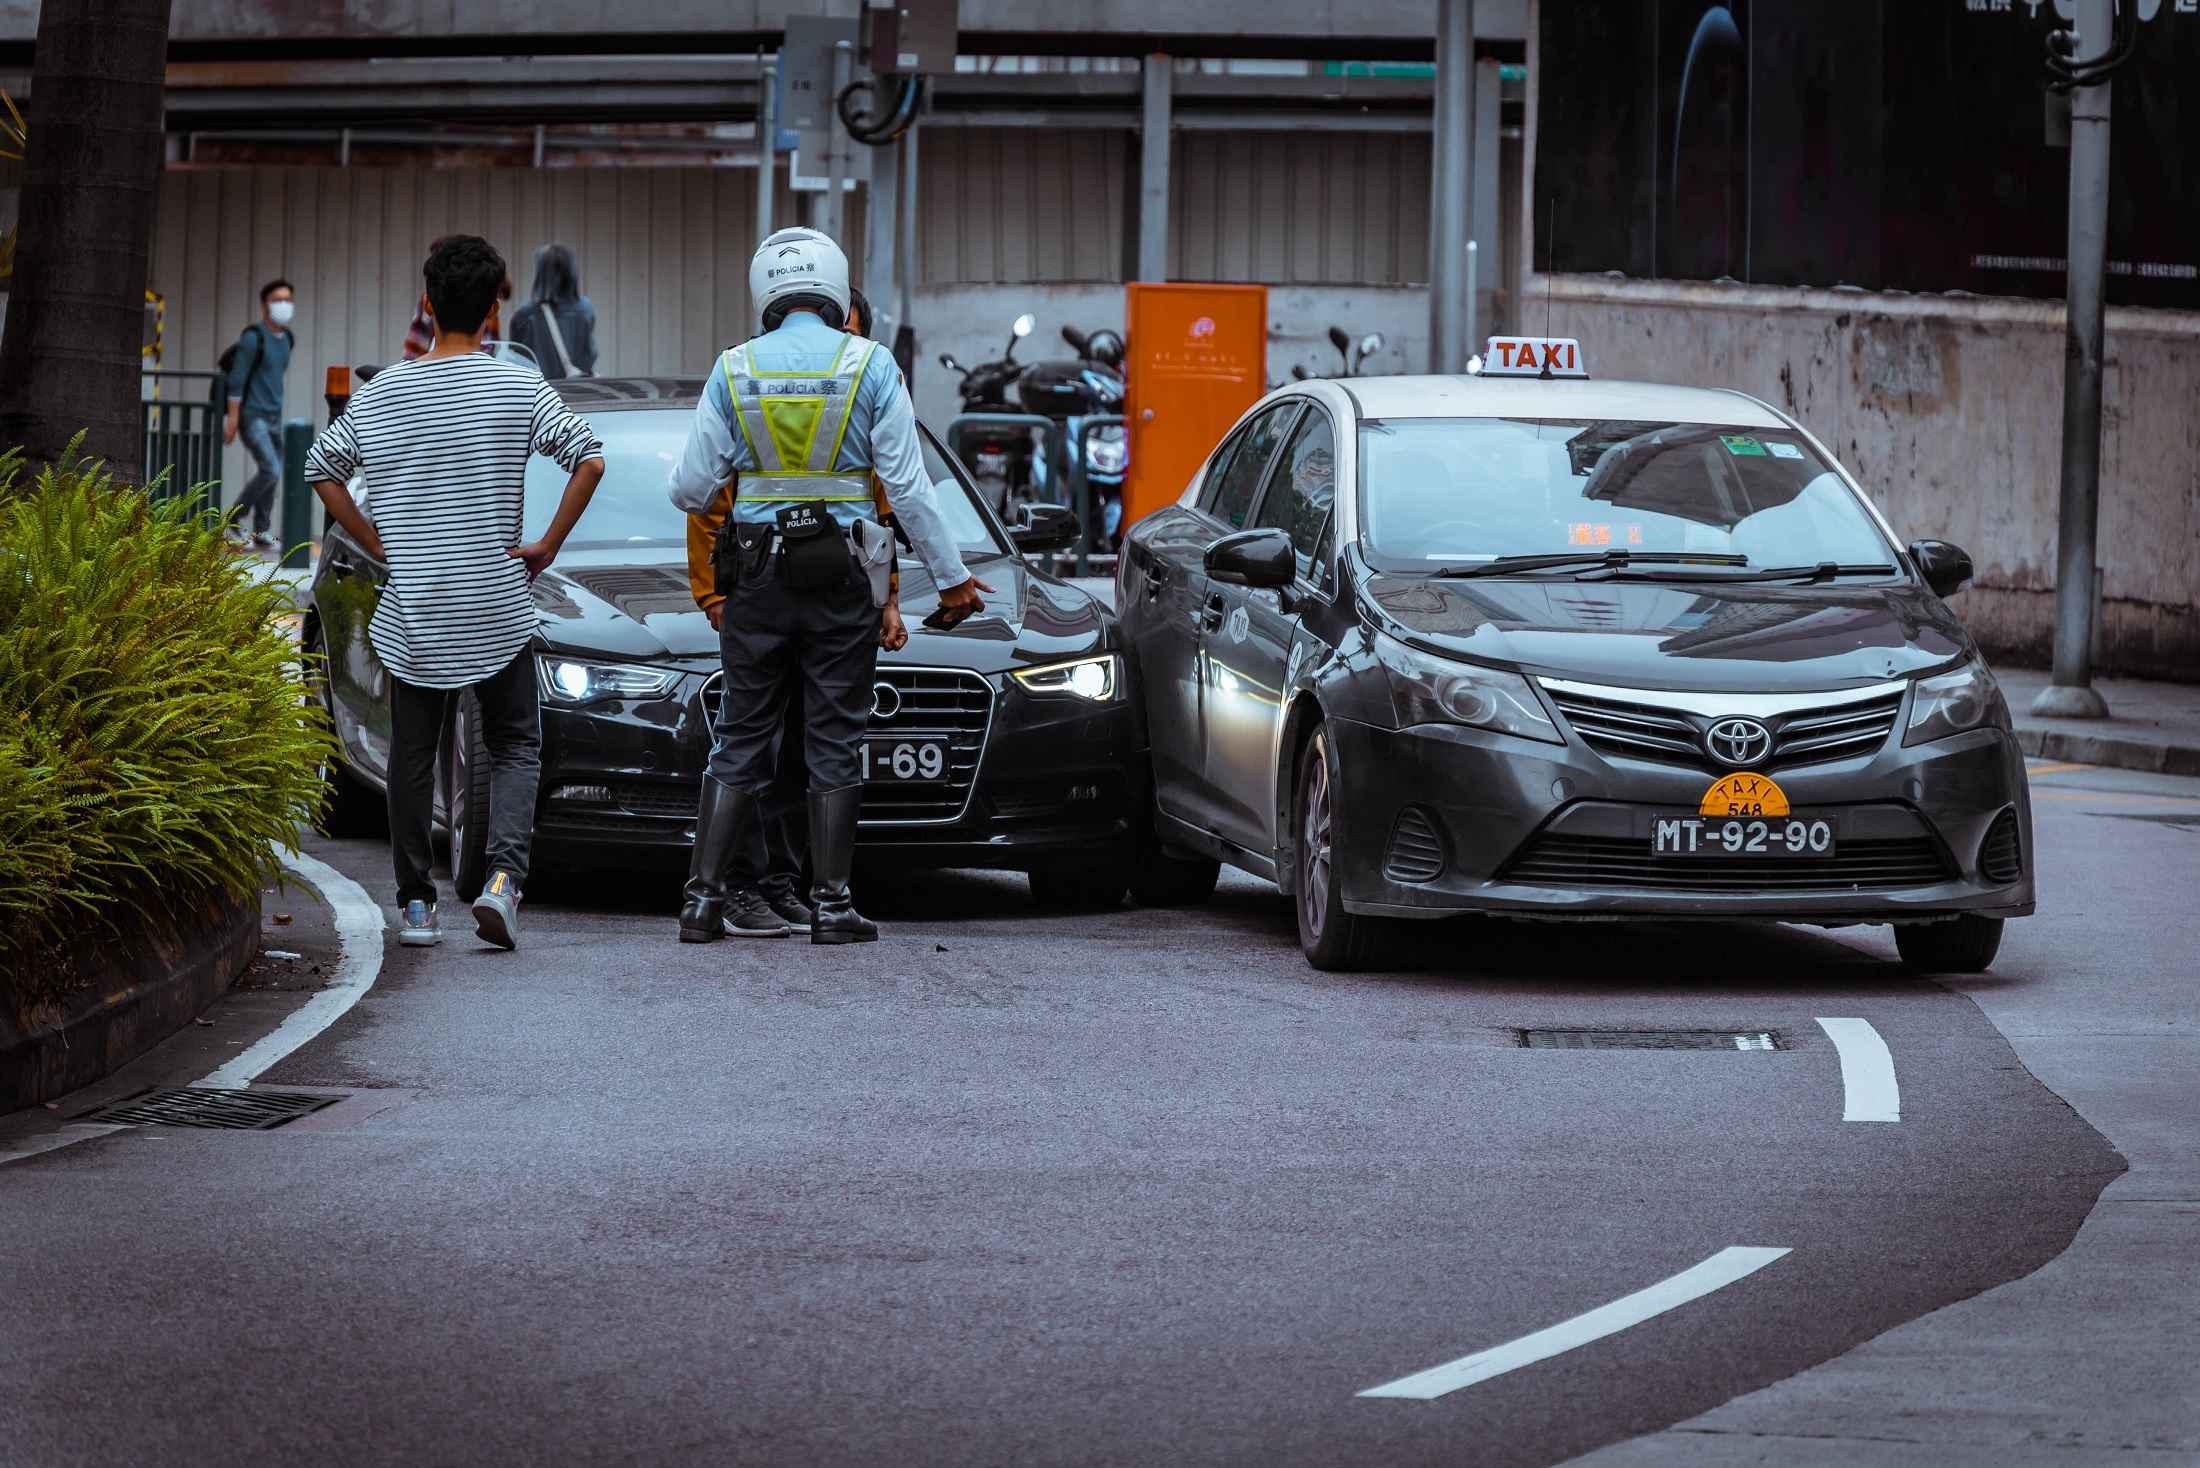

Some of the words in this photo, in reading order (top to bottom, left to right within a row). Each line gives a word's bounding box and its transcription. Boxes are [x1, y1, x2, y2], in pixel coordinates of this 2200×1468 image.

[1496, 342, 1574, 369] TAXI
[1716, 778, 1772, 800] TAXI
[1727, 802, 1763, 817] 548
[1657, 820, 1831, 852] MT-92-90
